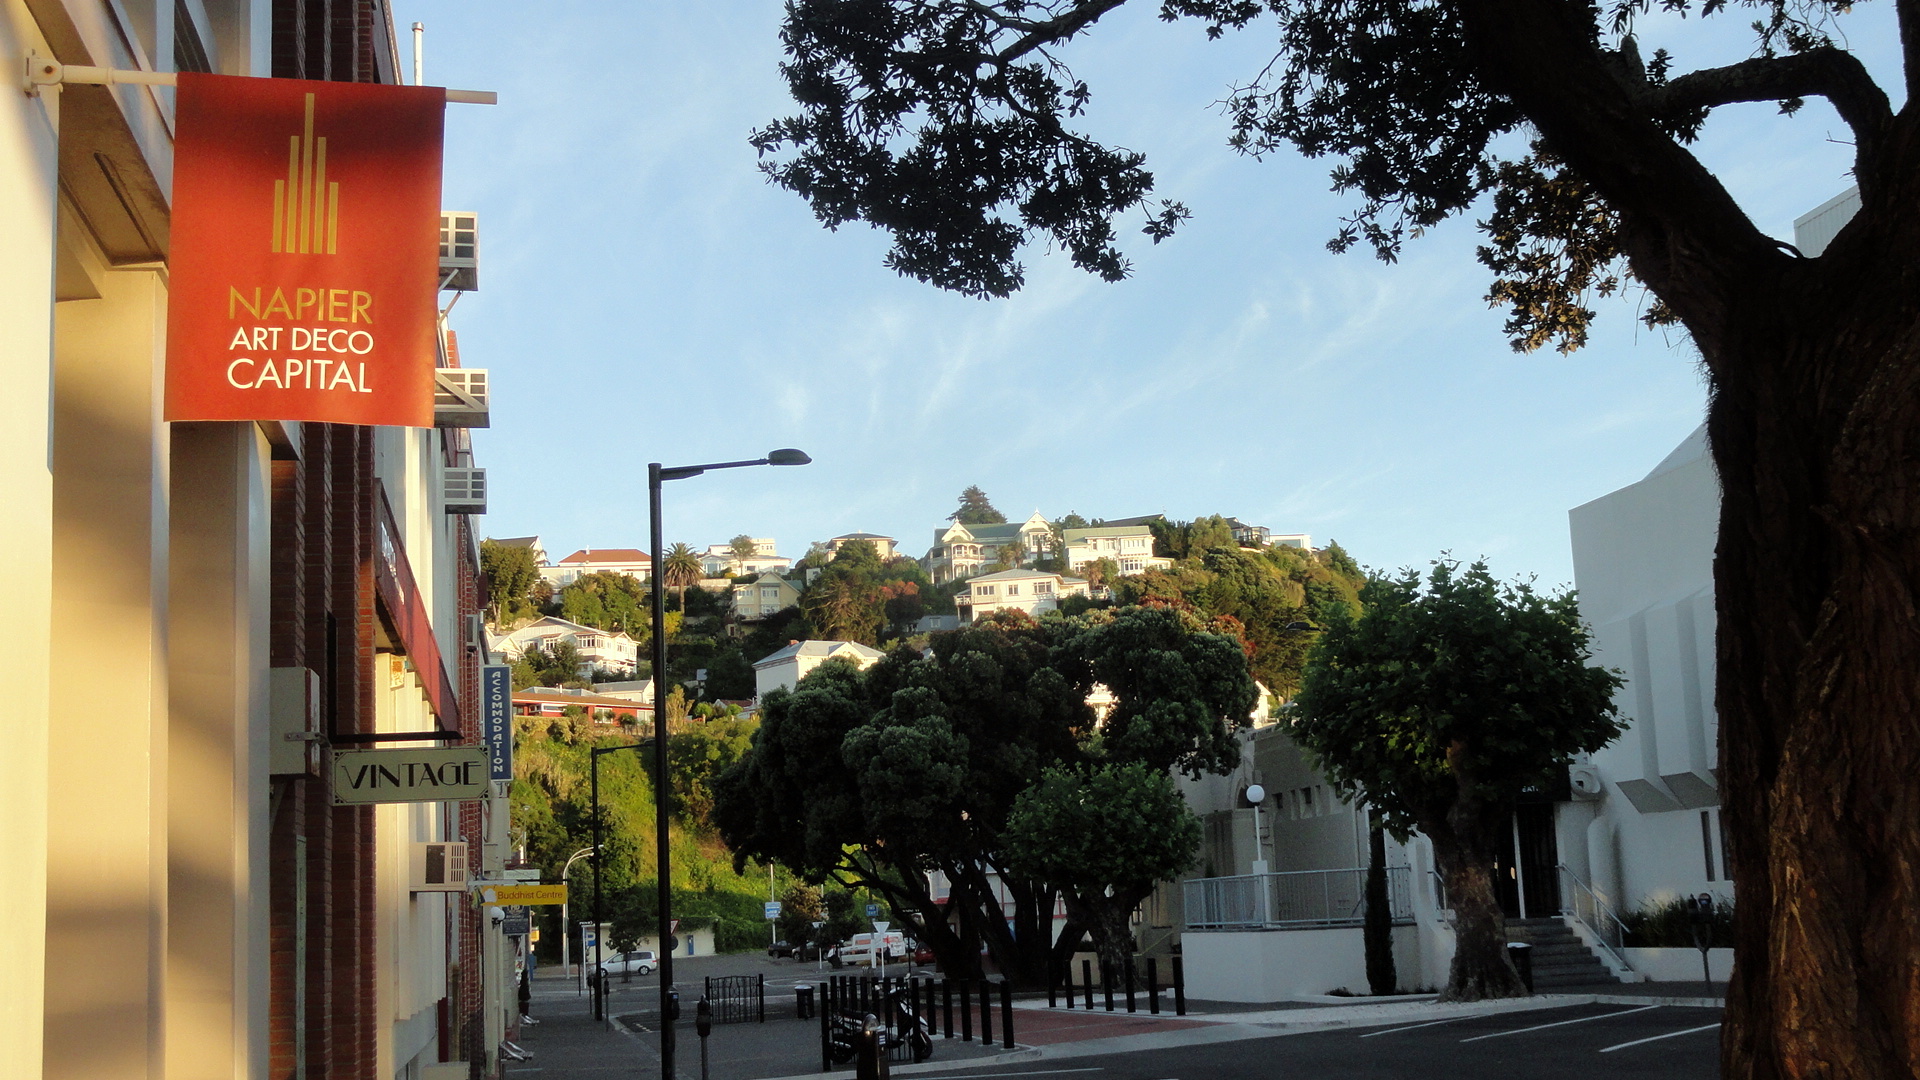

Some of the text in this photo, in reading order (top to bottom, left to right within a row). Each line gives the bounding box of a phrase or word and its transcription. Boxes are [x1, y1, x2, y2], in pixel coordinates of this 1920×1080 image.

[229, 285, 373, 324] NAPIER
[229, 326, 374, 355] ART DECO
[227, 358, 372, 393] CAPITAL
[491, 671, 503, 773] ACCOMMODATION
[341, 761, 482, 789] VINTAGE
[497, 890, 563, 900] Buddhist Centre
